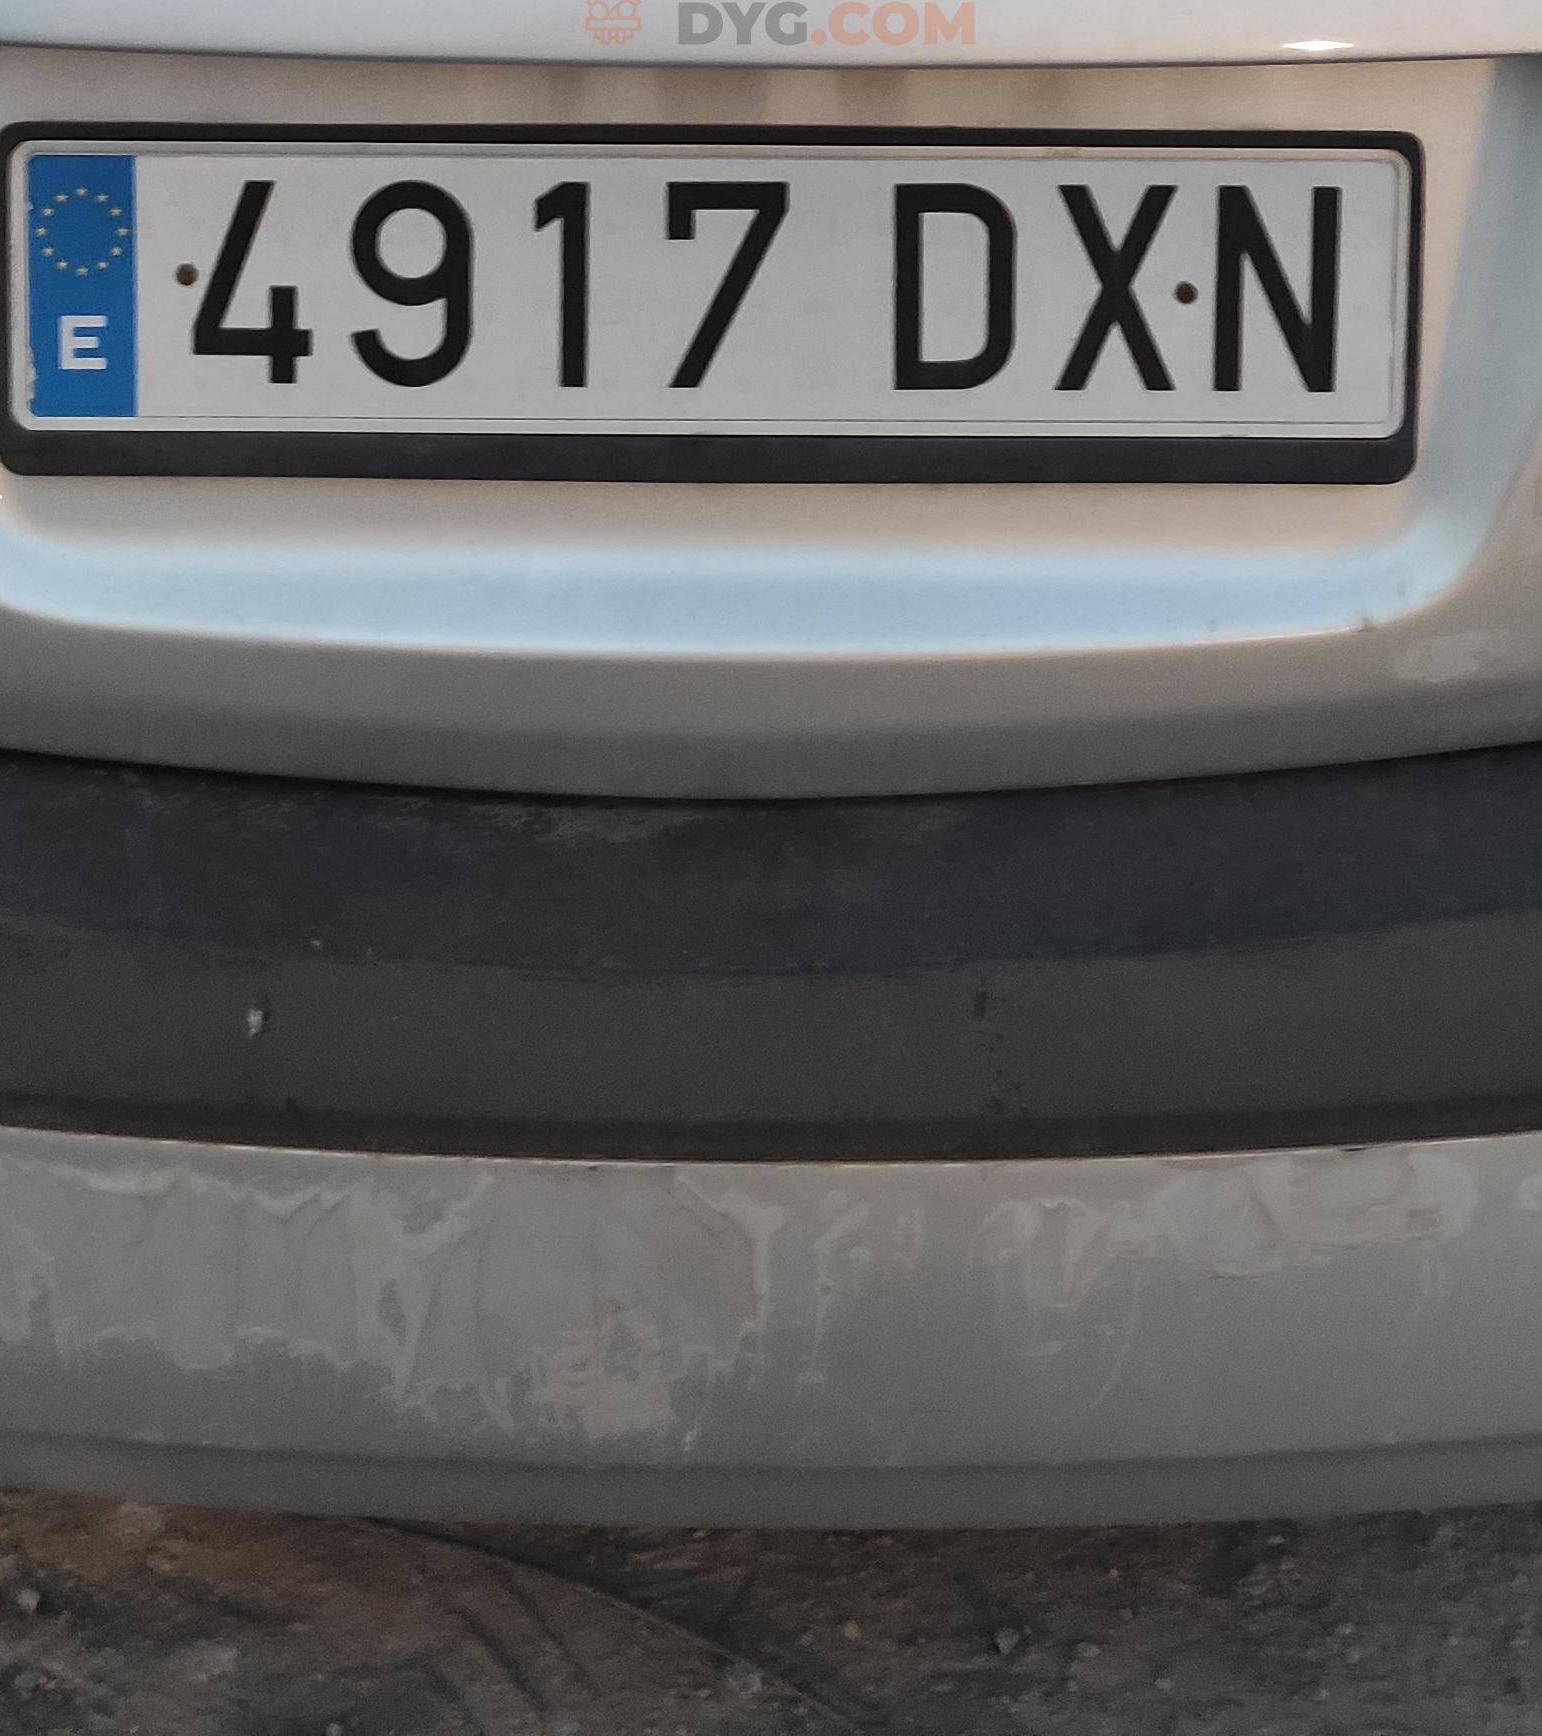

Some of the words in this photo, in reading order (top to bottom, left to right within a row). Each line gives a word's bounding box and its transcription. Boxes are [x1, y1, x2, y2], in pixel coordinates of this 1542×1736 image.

[58, 314, 109, 371] E
[191, 178, 791, 390] 4917
[892, 181, 1343, 394] DXN
